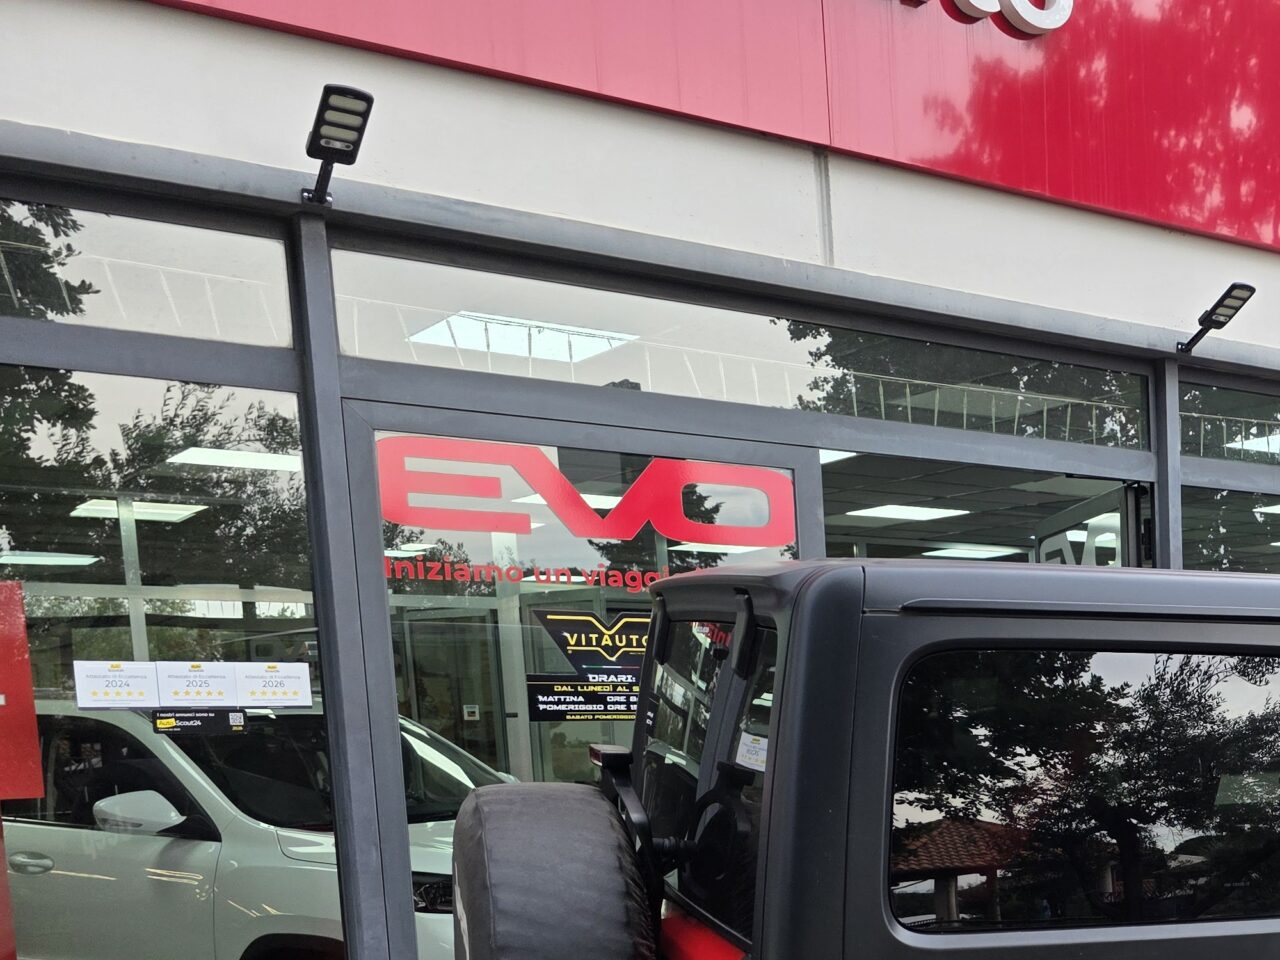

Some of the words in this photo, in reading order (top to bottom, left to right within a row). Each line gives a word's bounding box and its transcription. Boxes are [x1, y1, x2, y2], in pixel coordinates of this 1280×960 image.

[376, 435, 796, 548] EVO
[385, 554, 523, 584] Iniziamo
[533, 565, 573, 585] un
[581, 563, 669, 593] viagg
[104, 679, 130, 688] 2024
[185, 680, 210, 688] 2025
[262, 680, 286, 688] 2026
